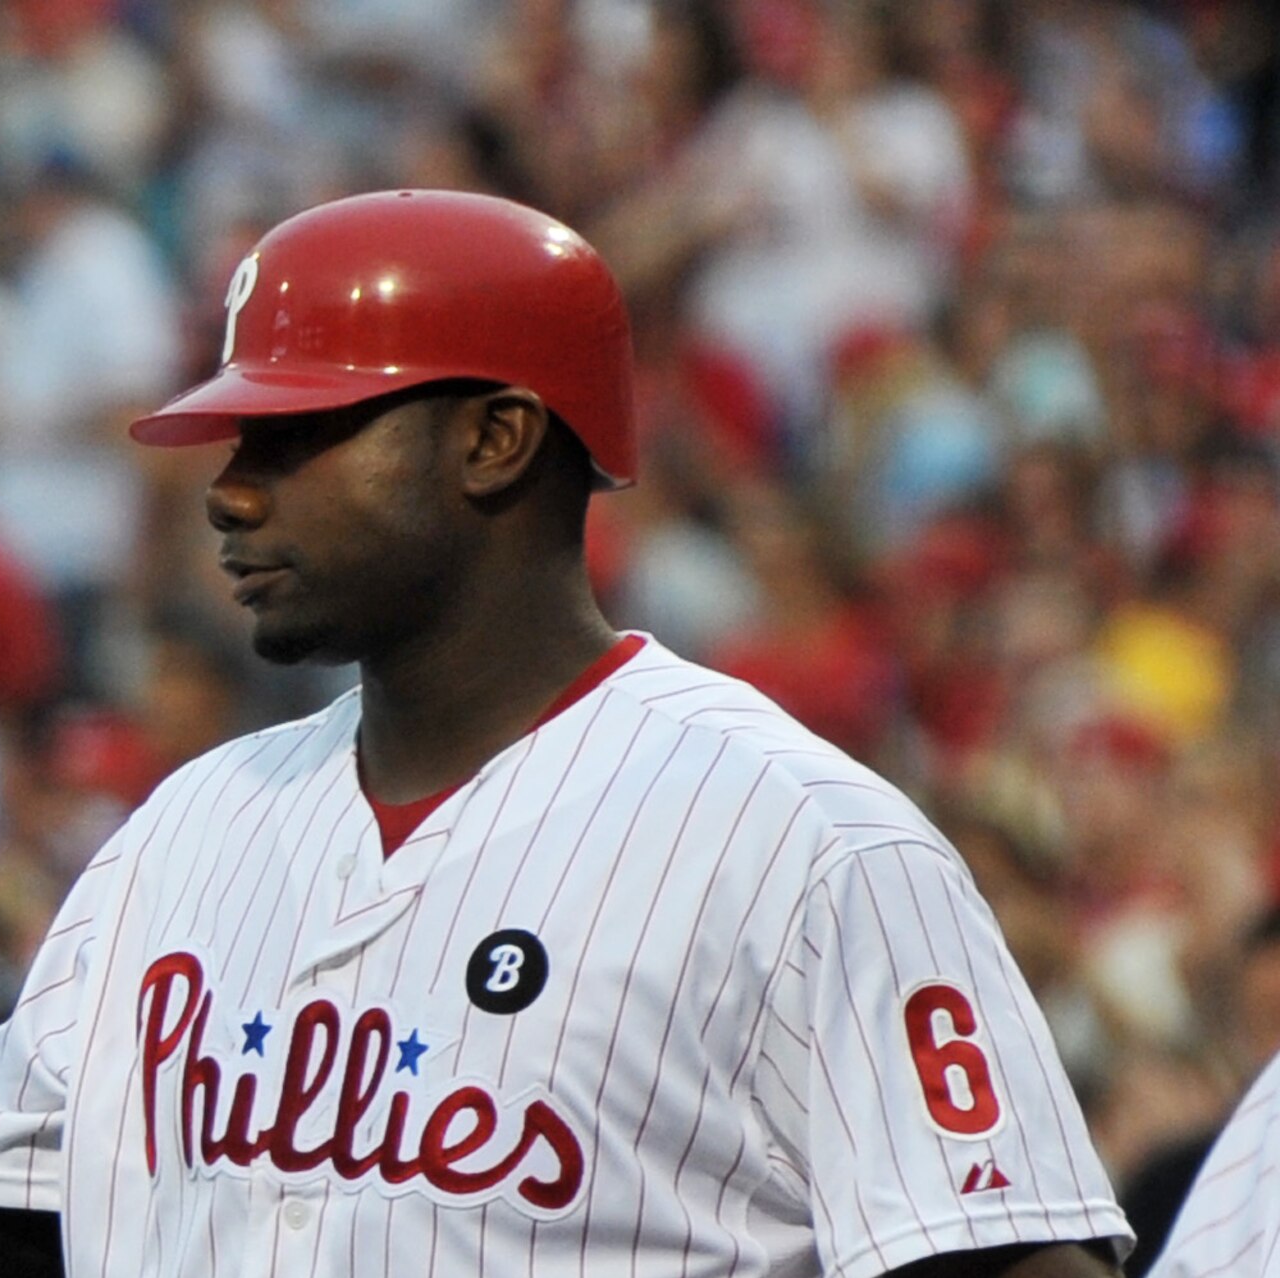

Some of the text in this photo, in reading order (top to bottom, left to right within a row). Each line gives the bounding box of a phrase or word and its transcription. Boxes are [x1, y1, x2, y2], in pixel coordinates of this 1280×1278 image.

[222, 257, 258, 364] P
[485, 943, 525, 992] B
[138, 951, 585, 1210] Phillies
[904, 984, 1001, 1136] 6
